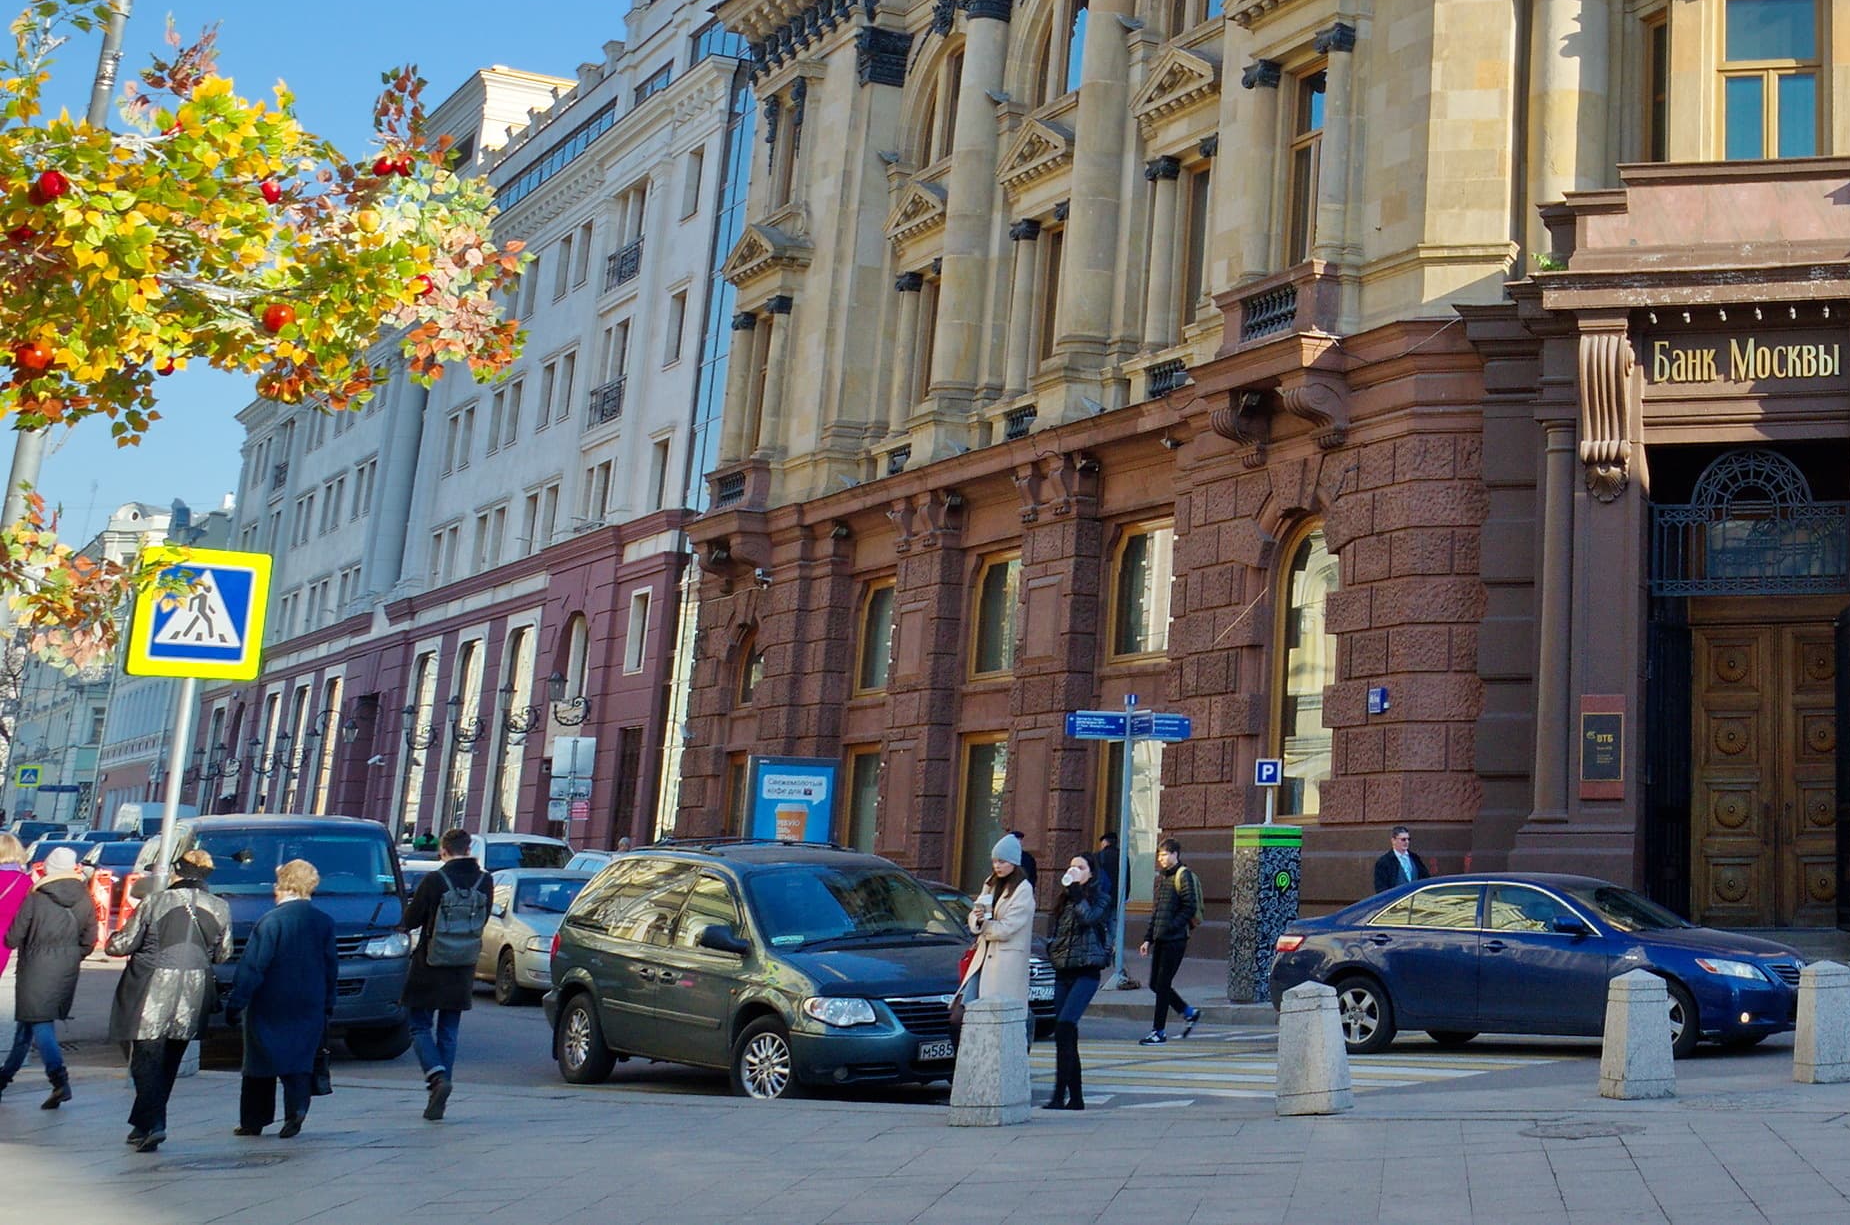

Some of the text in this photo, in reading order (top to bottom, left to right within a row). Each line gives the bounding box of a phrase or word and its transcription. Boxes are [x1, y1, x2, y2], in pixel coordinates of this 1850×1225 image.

[1653, 337, 1841, 383] Банк Москвы
[1261, 764, 1274, 780] P
